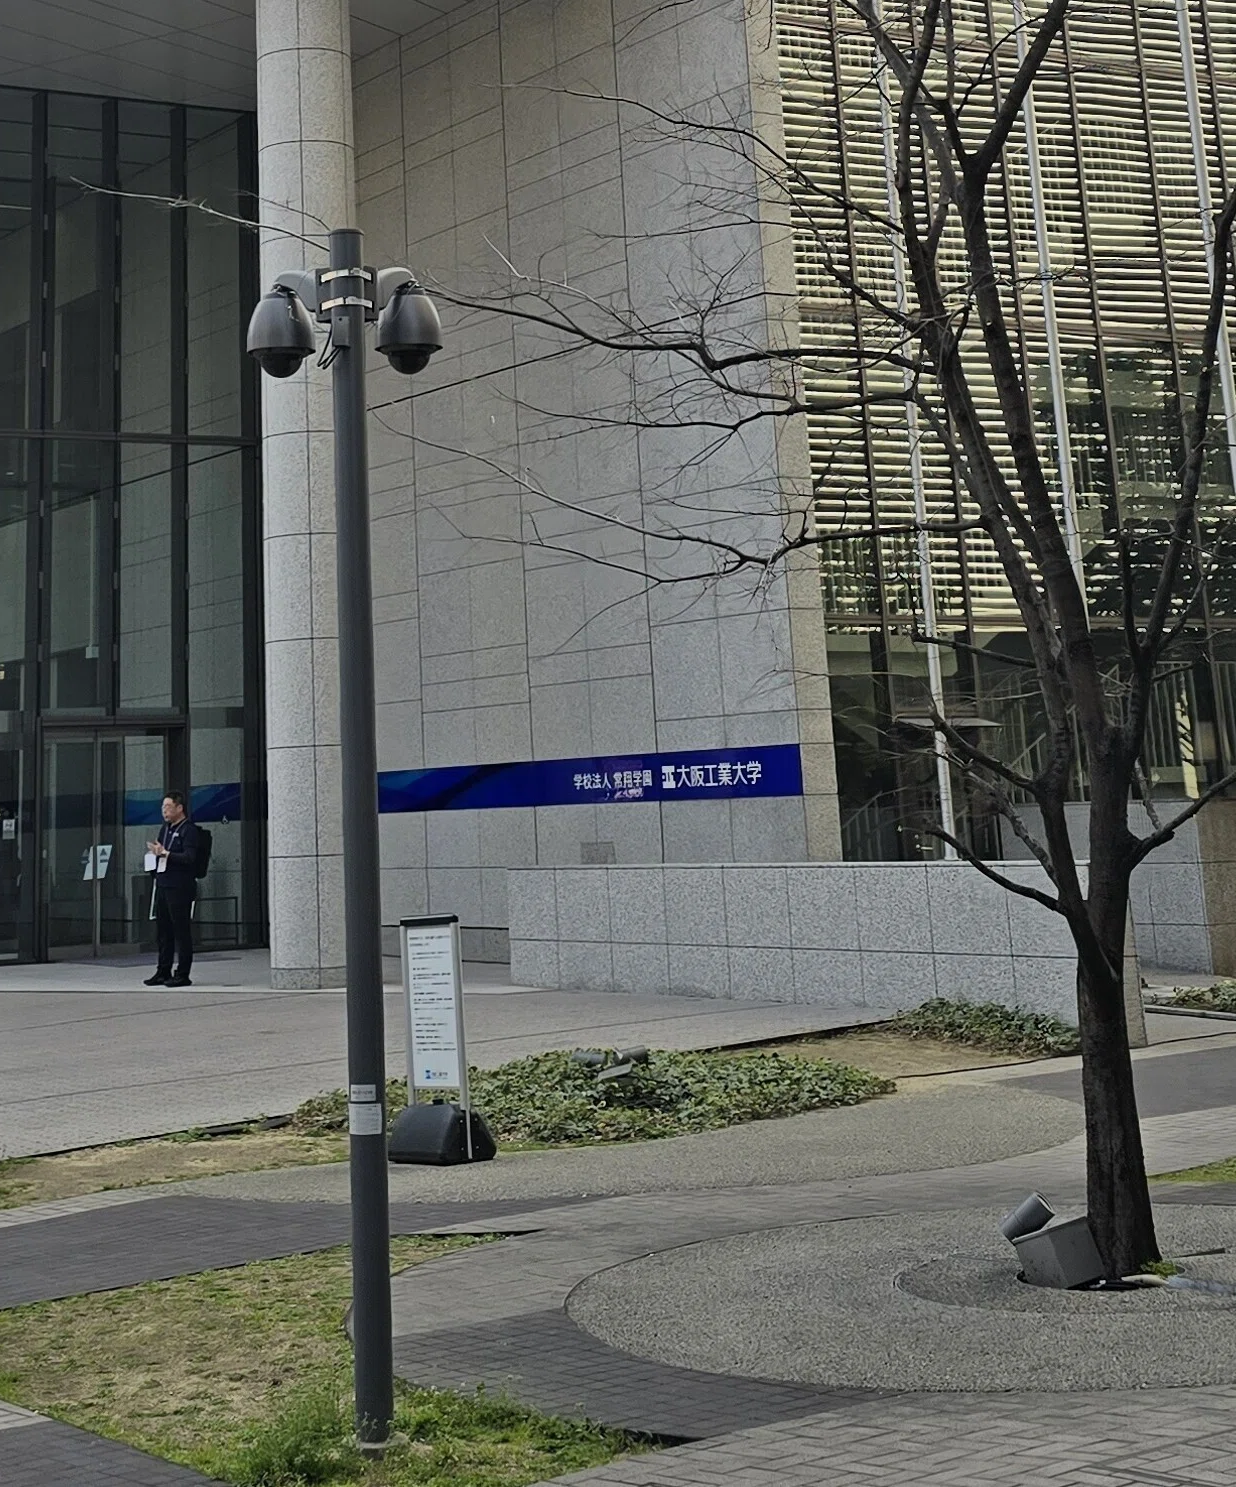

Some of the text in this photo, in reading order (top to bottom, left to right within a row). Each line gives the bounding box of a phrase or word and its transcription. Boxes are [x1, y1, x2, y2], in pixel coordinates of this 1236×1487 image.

[677, 760, 762, 788] 大阪工業大学
